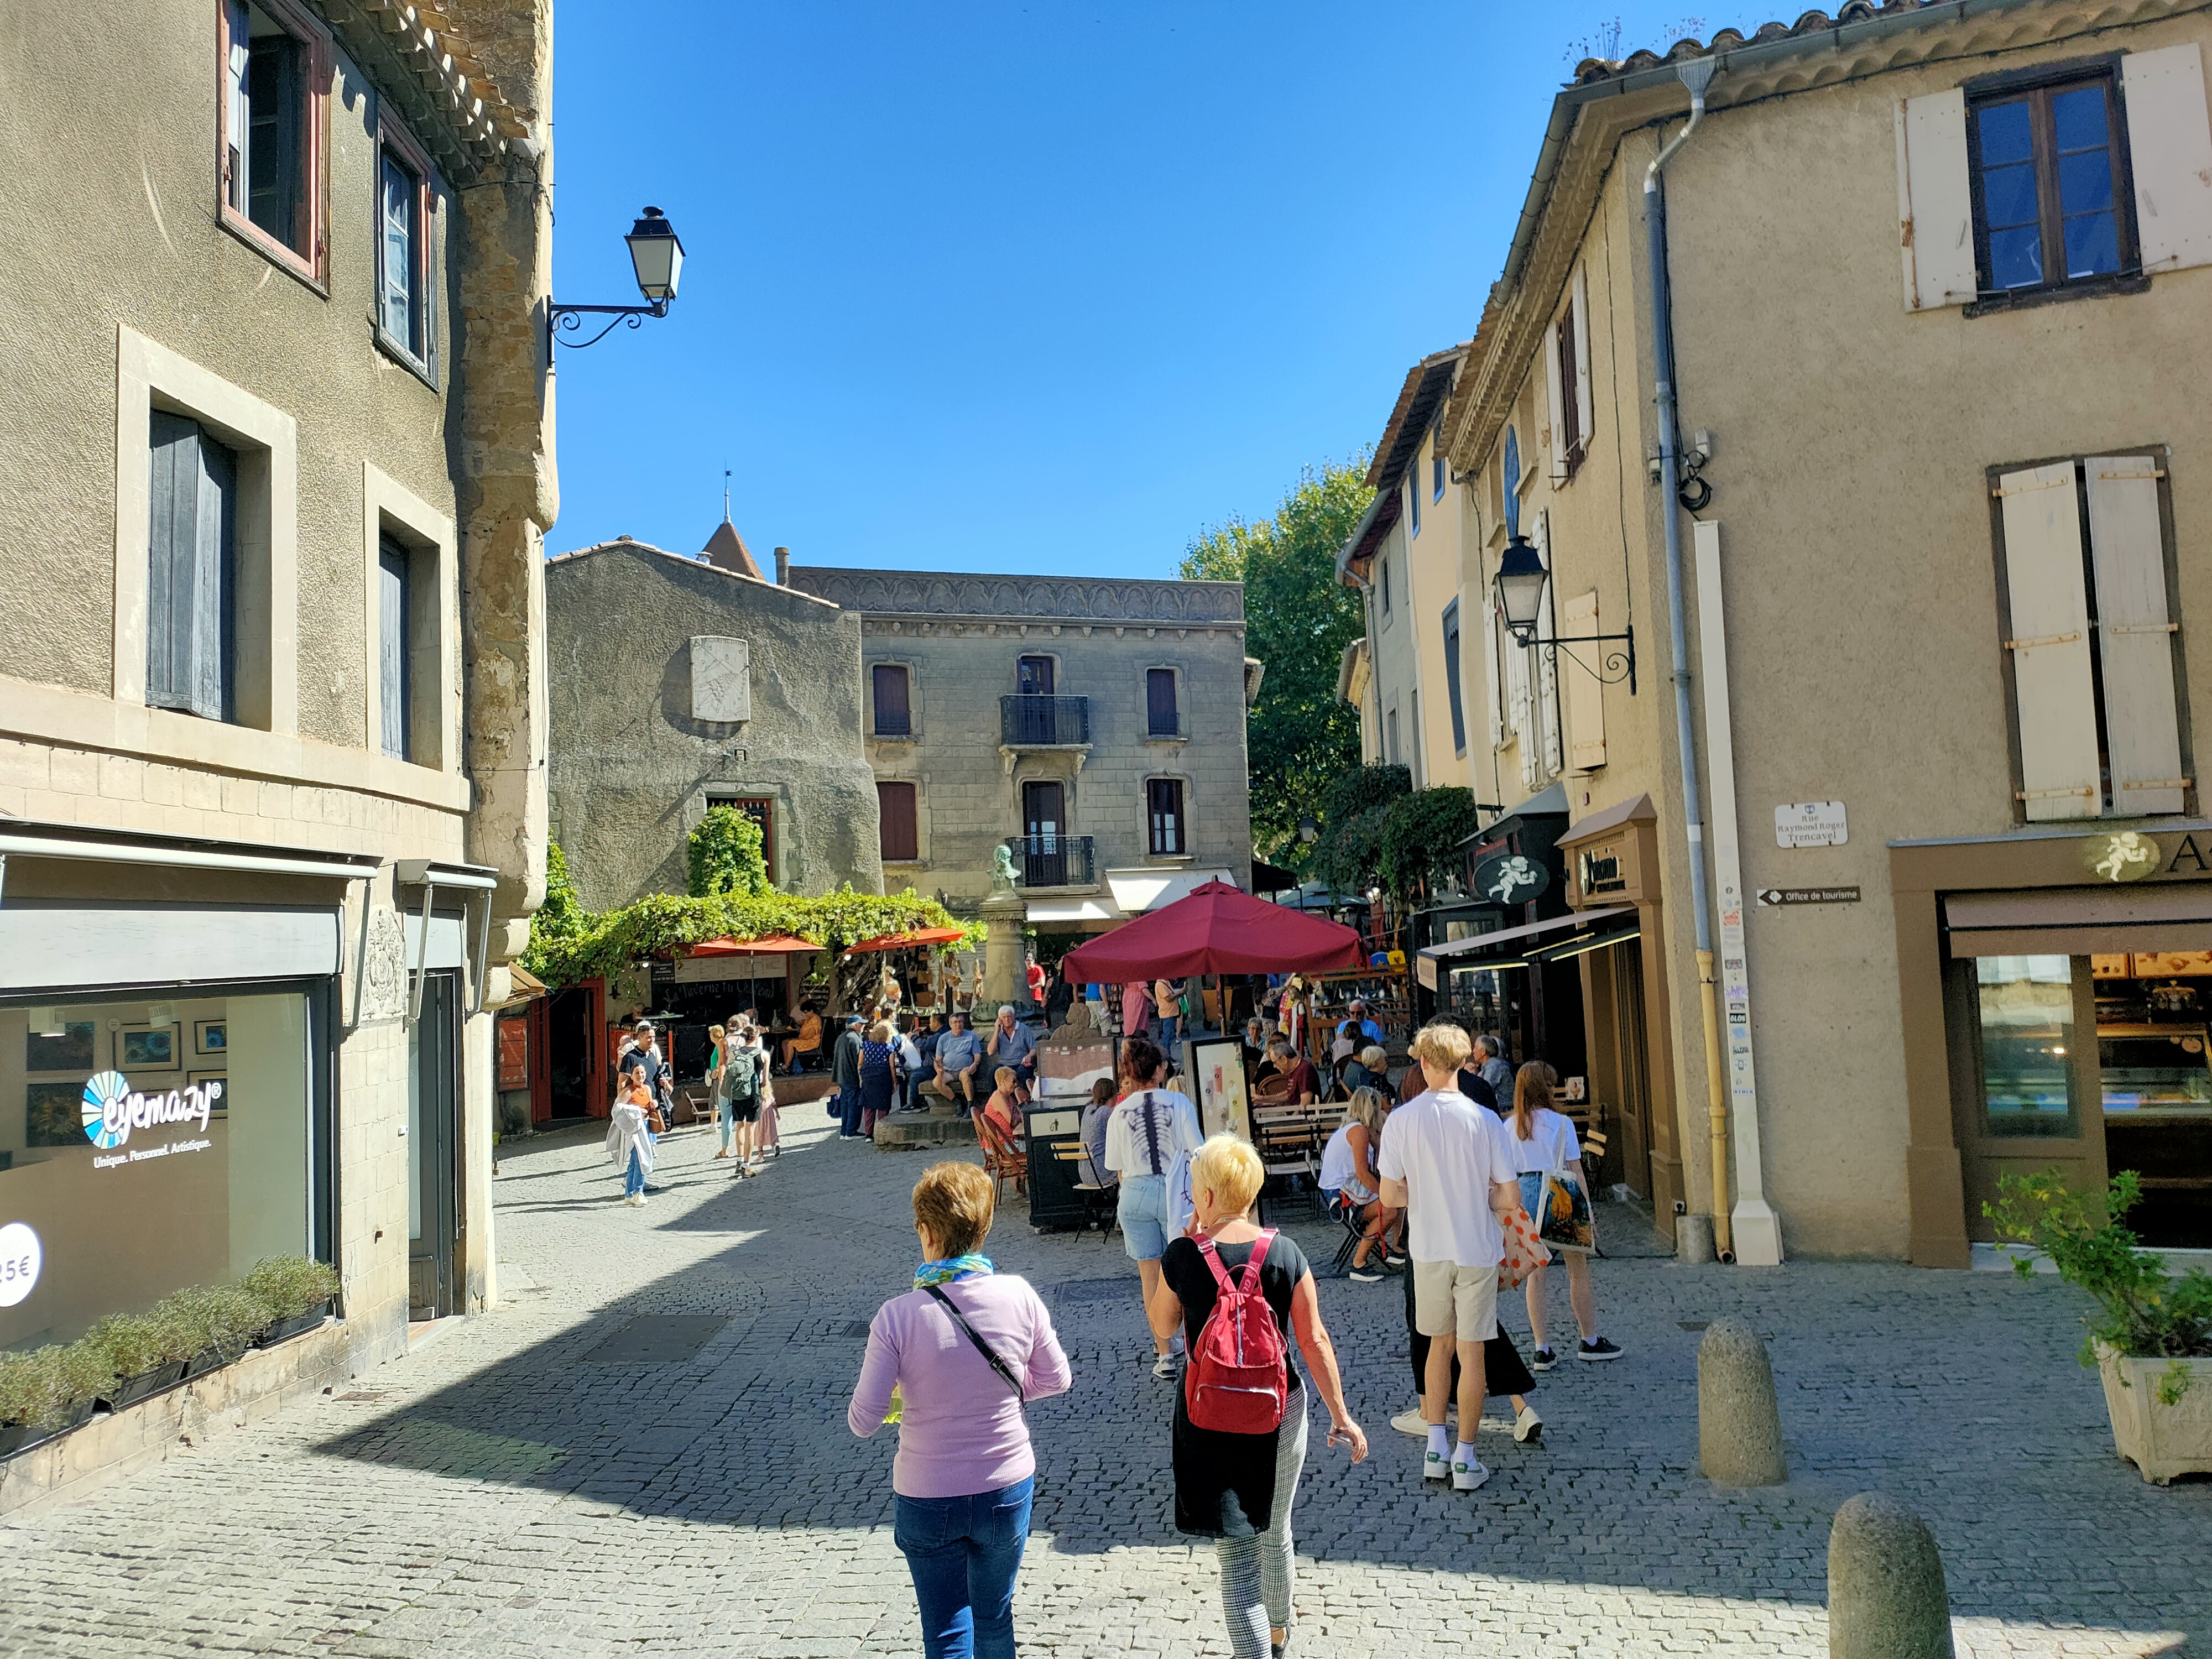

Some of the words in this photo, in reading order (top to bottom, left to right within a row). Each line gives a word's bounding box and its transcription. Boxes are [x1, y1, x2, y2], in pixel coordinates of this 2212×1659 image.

[1778, 823, 1818, 833] Raymond
[1788, 831, 1837, 842] Trencavel
[2165, 833, 2212, 872] A
[1786, 892, 1809, 901] Office
[1811, 891, 1820, 901] de
[1822, 890, 1858, 900] tourisme
[93, 1155, 128, 1168] Unique.
[129, 1144, 169, 1162] Personnel.
[170, 1139, 212, 1154] Artistique.
[0, 1256, 30, 1284] 5€
